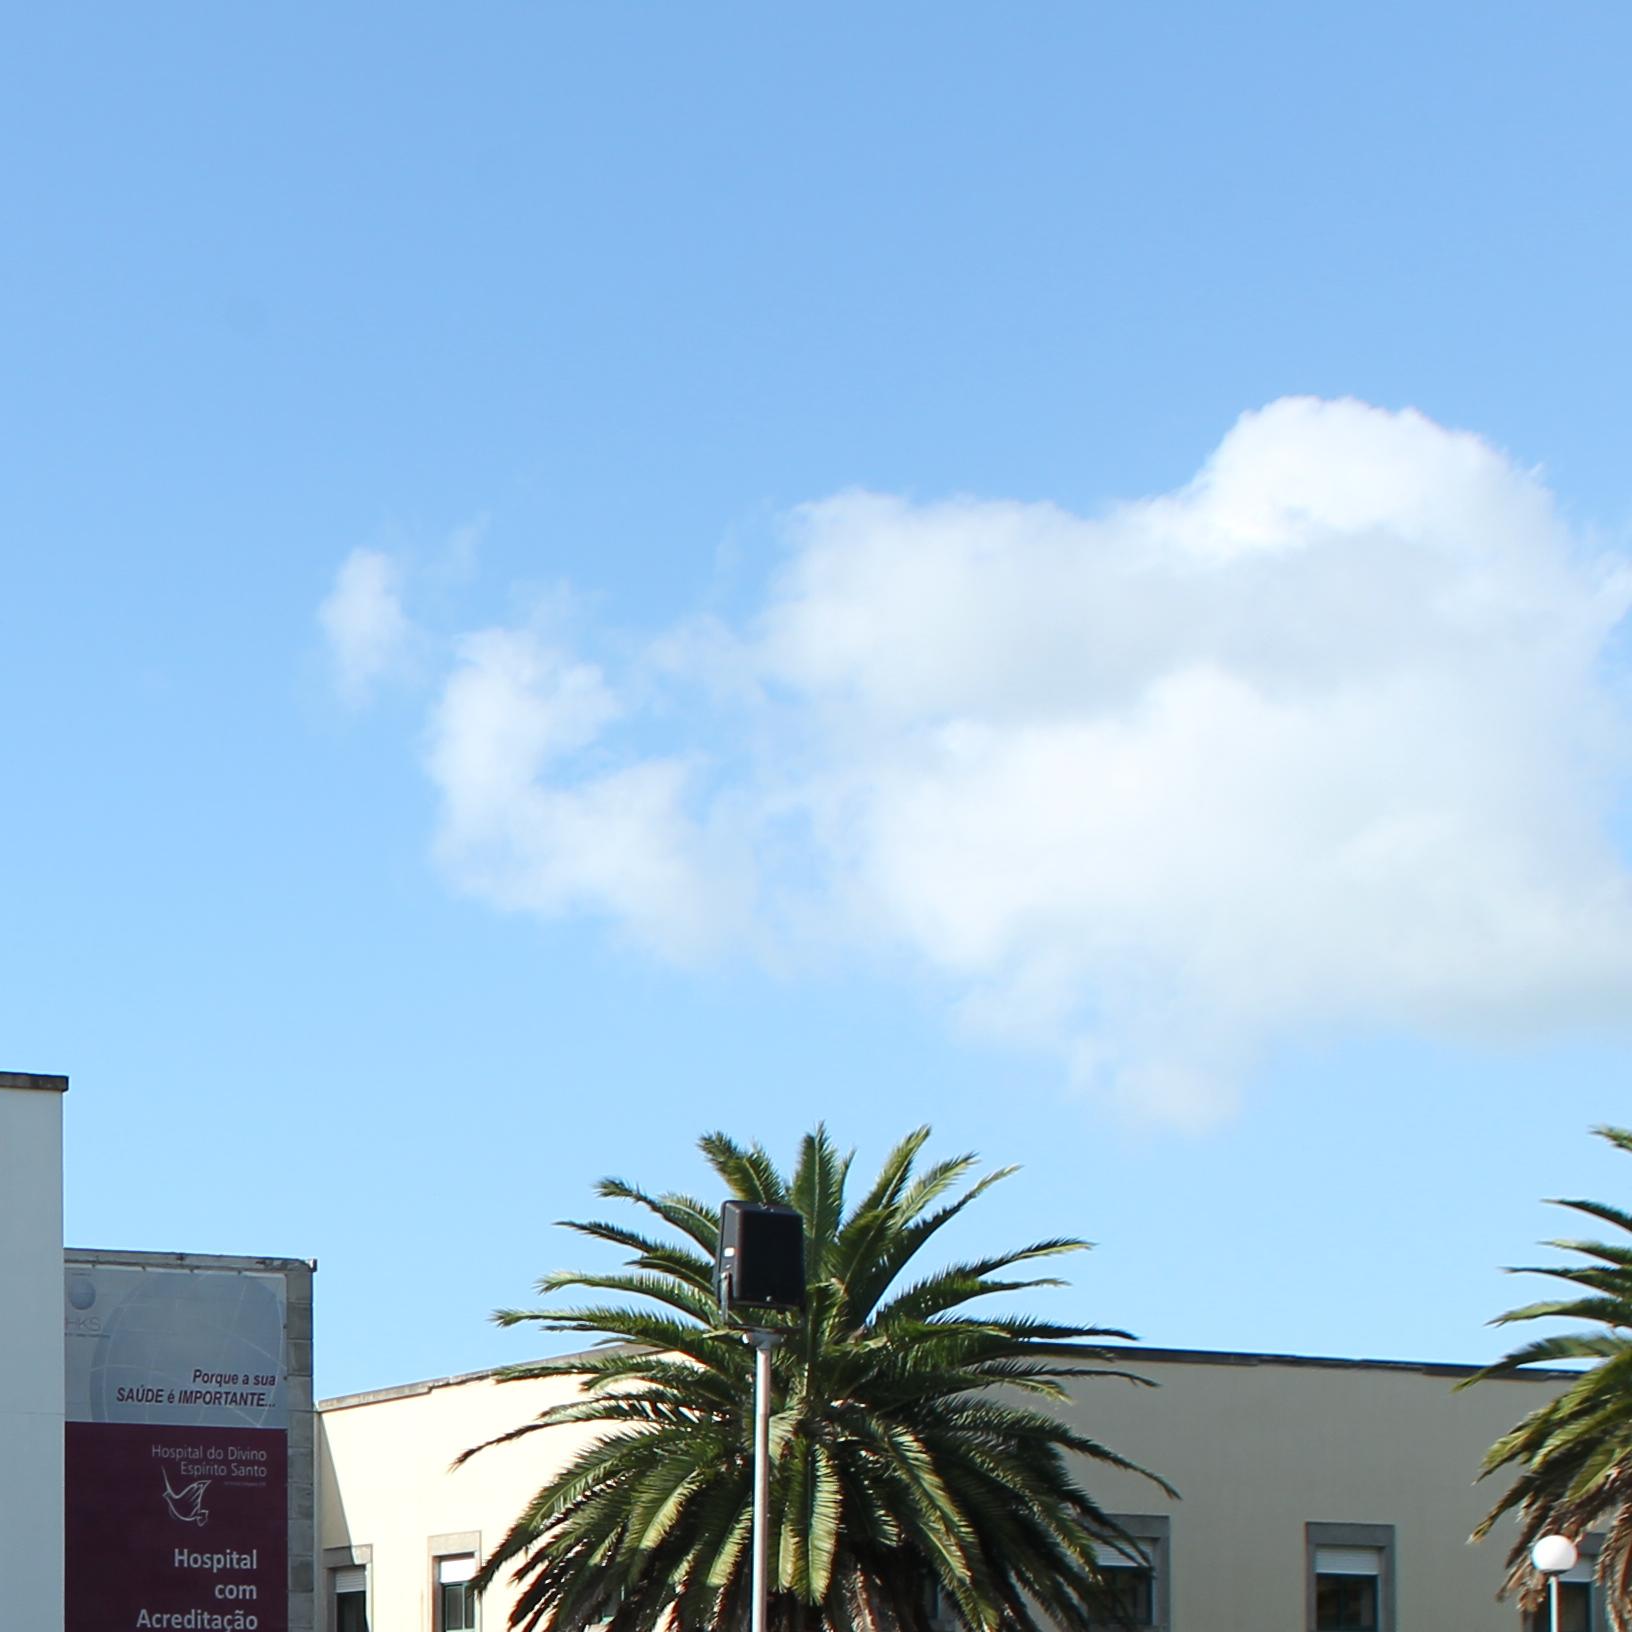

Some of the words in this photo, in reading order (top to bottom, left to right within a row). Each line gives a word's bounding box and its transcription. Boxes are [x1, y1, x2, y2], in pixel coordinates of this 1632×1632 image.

[192, 1369, 239, 1386] Porque
[242, 1374, 250, 1385] a
[253, 1374, 276, 1386] sua
[116, 1385, 164, 1403] SAÚDE
[167, 1389, 174, 1404] é
[178, 1390, 276, 1407] IMPORTANTE...
[152, 1444, 203, 1460] Hospital
[207, 1446, 224, 1460] do
[228, 1446, 267, 1461] Divino
[180, 1461, 227, 1477] Espírito
[231, 1463, 267, 1477] Santo
[174, 1549, 257, 1573] Hospital
[214, 1584, 257, 1599] com
